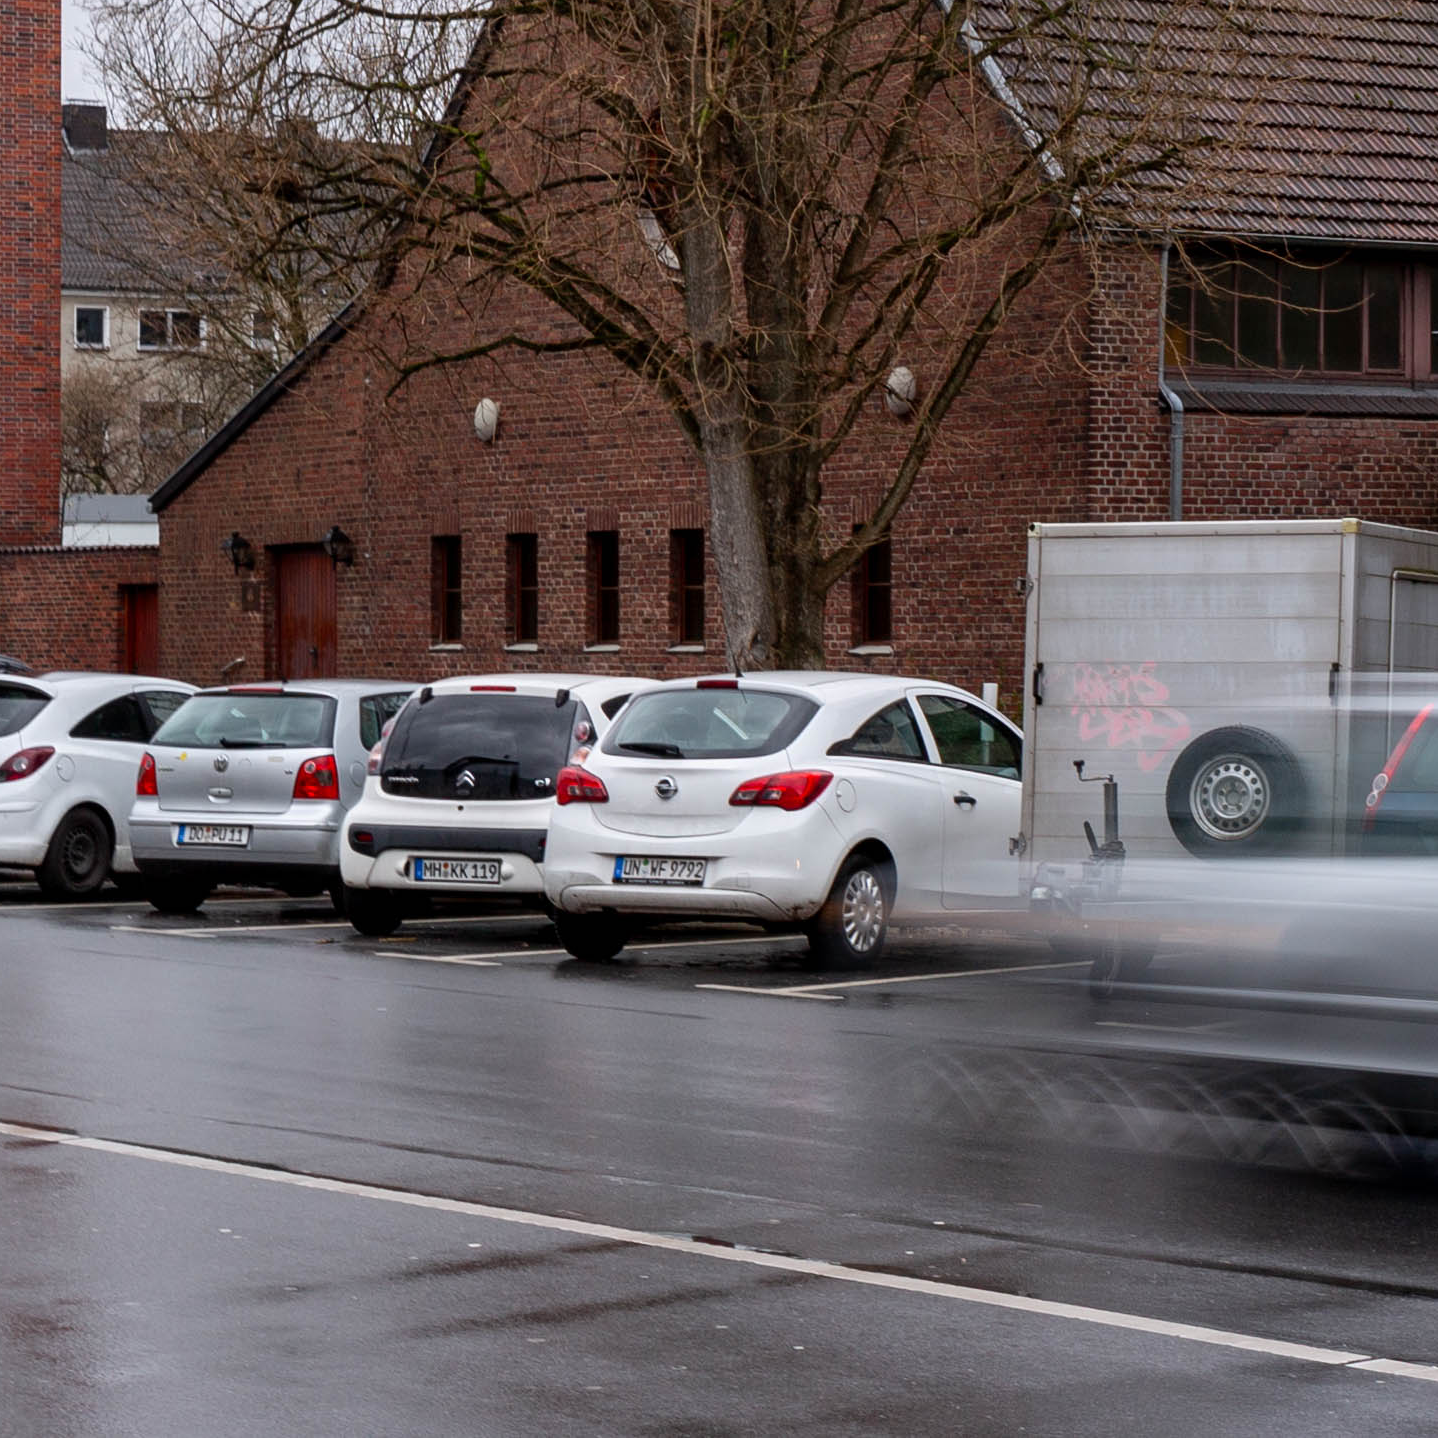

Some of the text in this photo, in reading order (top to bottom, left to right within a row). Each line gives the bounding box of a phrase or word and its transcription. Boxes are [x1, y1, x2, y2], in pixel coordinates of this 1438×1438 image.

[189, 826, 243, 842] DO PU 11
[424, 862, 497, 879] MH KK 119
[624, 859, 704, 878] UN WF 9792
